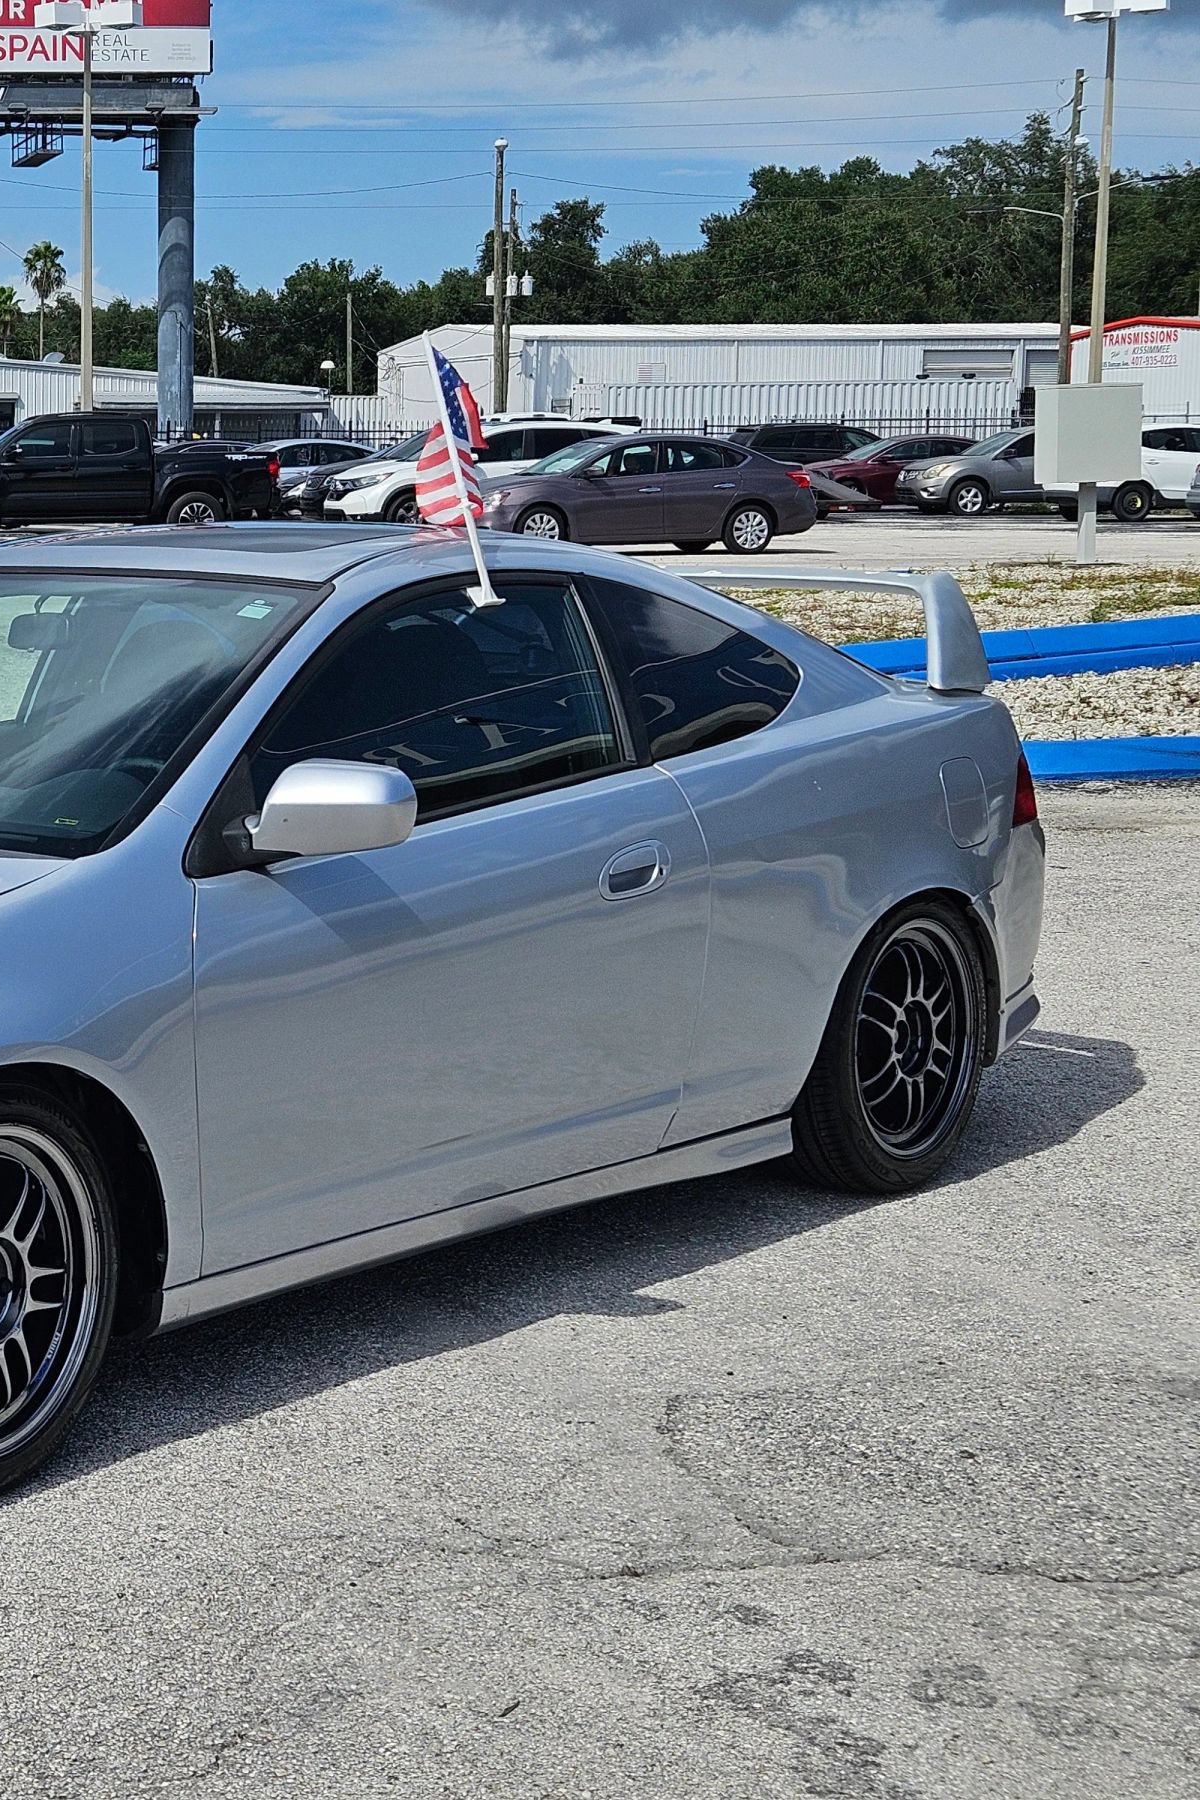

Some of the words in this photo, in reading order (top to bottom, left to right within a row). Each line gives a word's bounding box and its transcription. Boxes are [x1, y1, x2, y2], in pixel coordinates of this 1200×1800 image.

[91, 34, 133, 47] REAL
[91, 48, 150, 62] ESTATE
[1103, 330, 1179, 347] TRANSMISSIONS
[1131, 344, 1171, 355] KISSIMMEE
[1131, 354, 1178, 366] 407-935-0223
